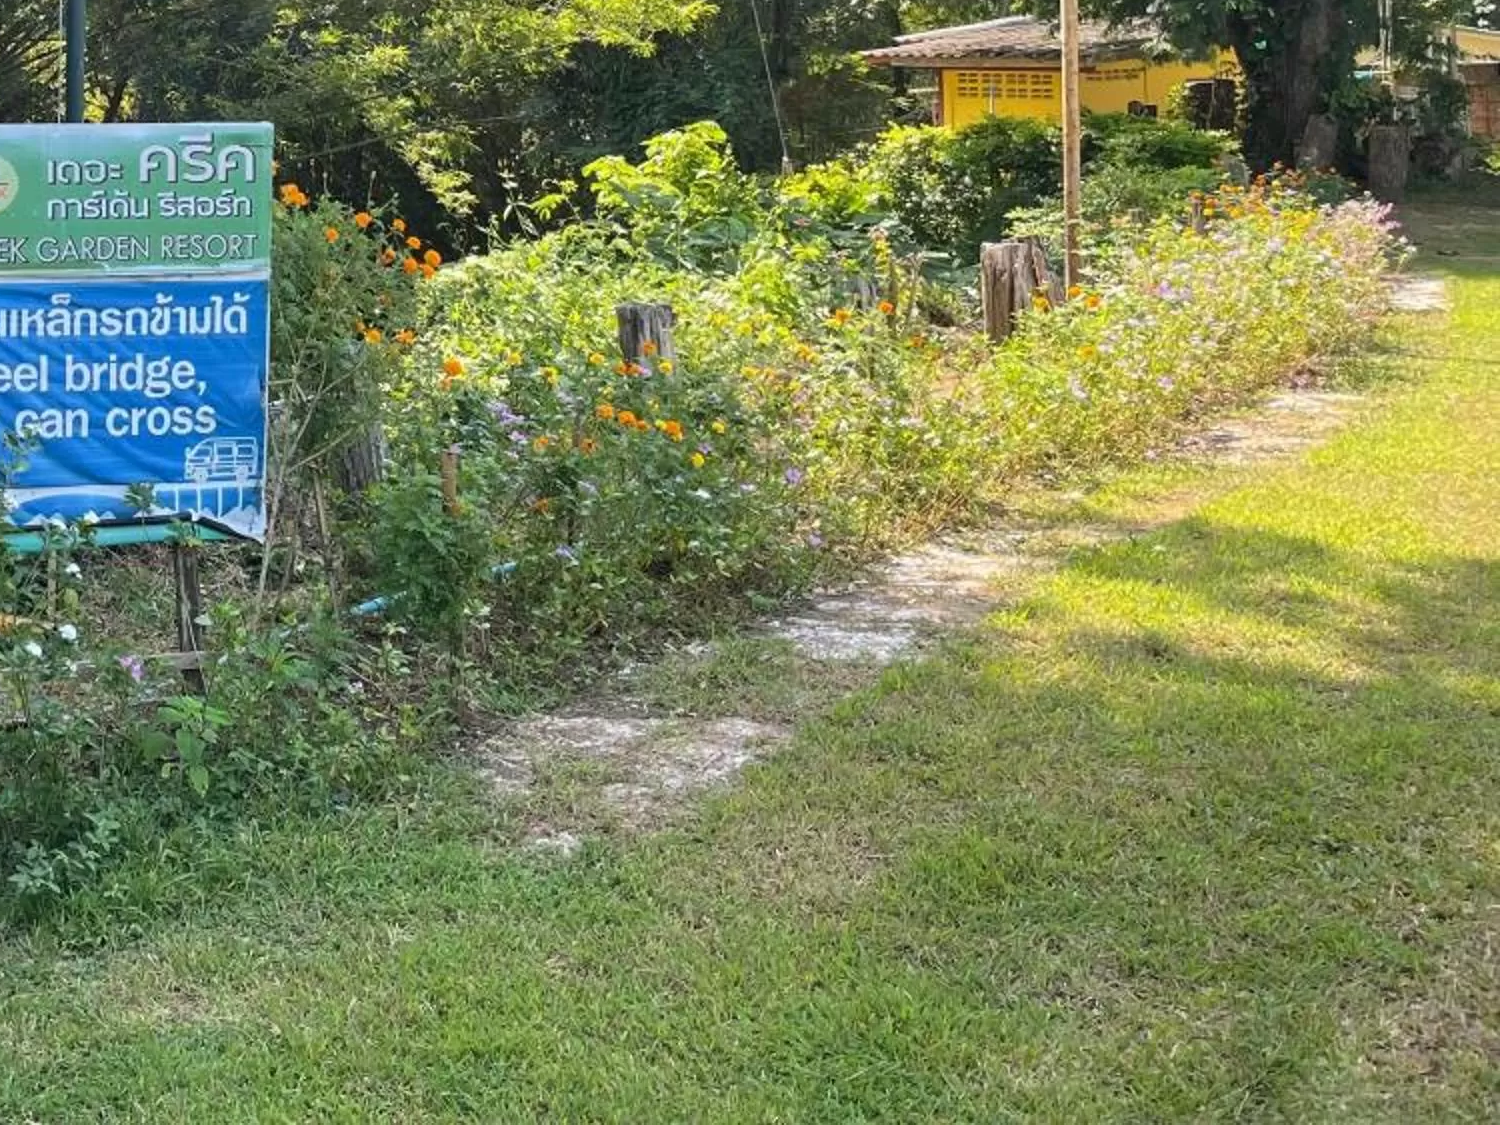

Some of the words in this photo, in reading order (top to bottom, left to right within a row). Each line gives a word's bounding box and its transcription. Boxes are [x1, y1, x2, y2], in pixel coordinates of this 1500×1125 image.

[48, 159, 124, 185] เดอะ
[138, 133, 257, 184] ครีค
[156, 188, 253, 218] รีสอร์ท
[36, 235, 150, 264] GARDEN
[160, 233, 259, 261] RESORT
[64, 353, 208, 399] bridge,
[14, 407, 90, 440] can
[104, 403, 218, 437] cross
